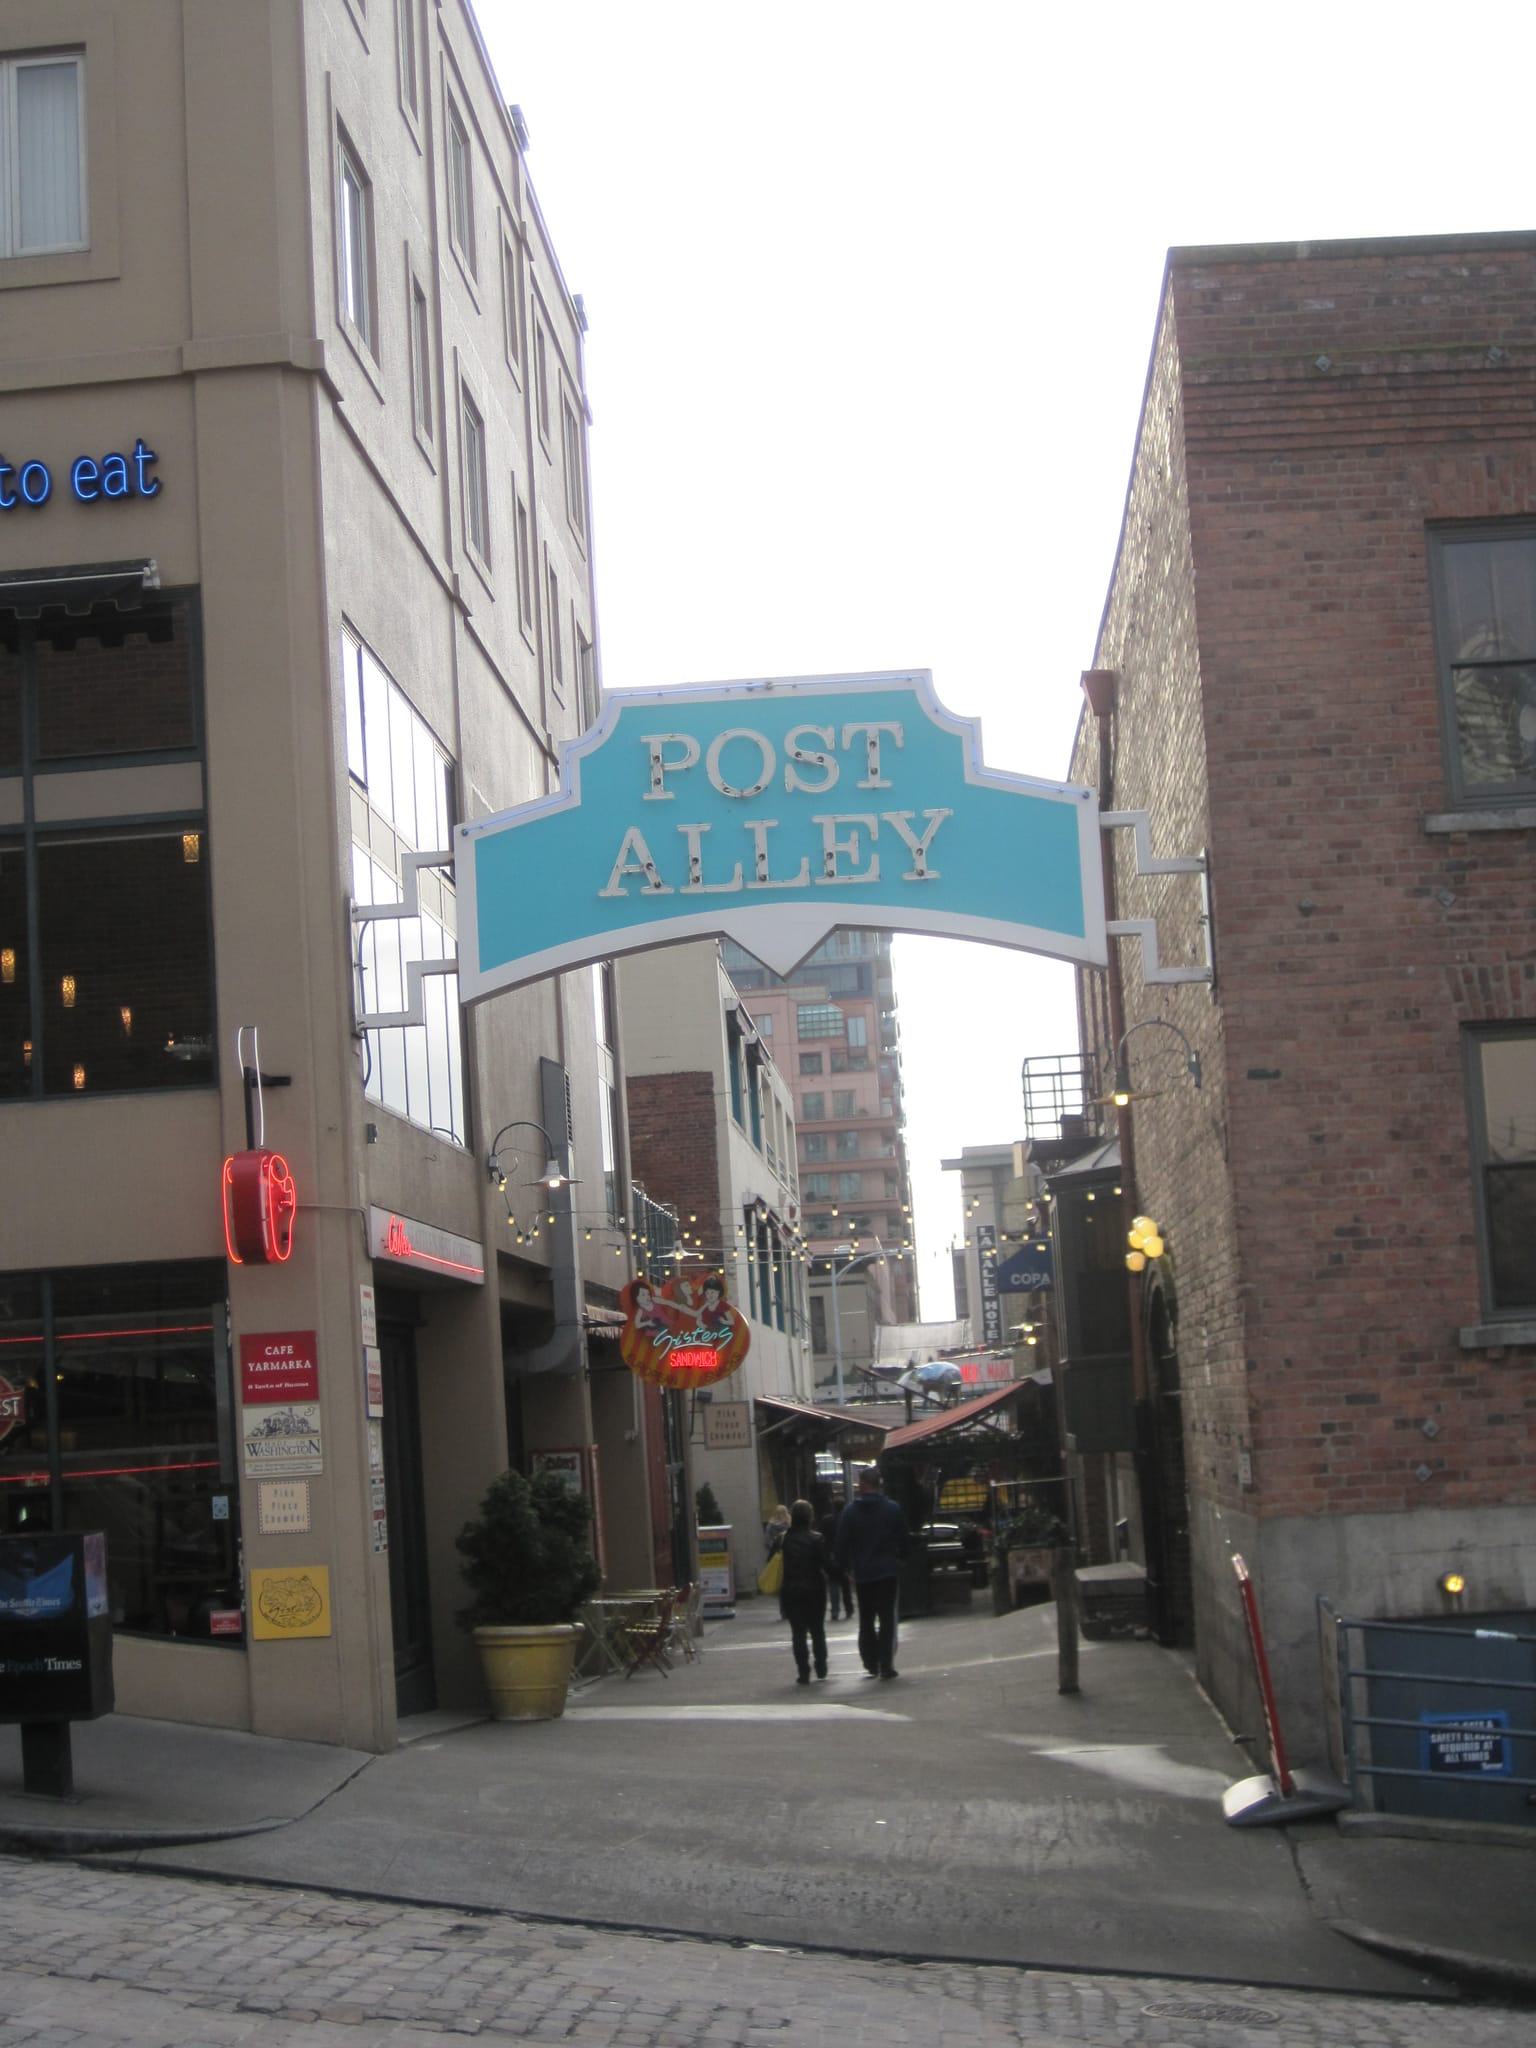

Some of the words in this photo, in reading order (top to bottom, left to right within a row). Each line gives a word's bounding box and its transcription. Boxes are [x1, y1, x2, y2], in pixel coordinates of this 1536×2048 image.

[71, 438, 162, 502] eat
[640, 721, 904, 800] POST
[597, 808, 954, 897] ALLEY
[980, 1227, 993, 1246] LA
[1011, 1272, 1051, 1286] COPA
[984, 1301, 999, 1344] HOTE
[265, 1345, 294, 1356] CAFE
[653, 1326, 733, 1360] Sisters
[248, 1360, 312, 1372] YARMARKA
[670, 1351, 717, 1367] SANDWICH
[0, 1397, 22, 1417] ST
[246, 1439, 321, 1457] WASHINGTON
[44, 1657, 82, 1671] Times
[1463, 1751, 1490, 1761] TIMES
